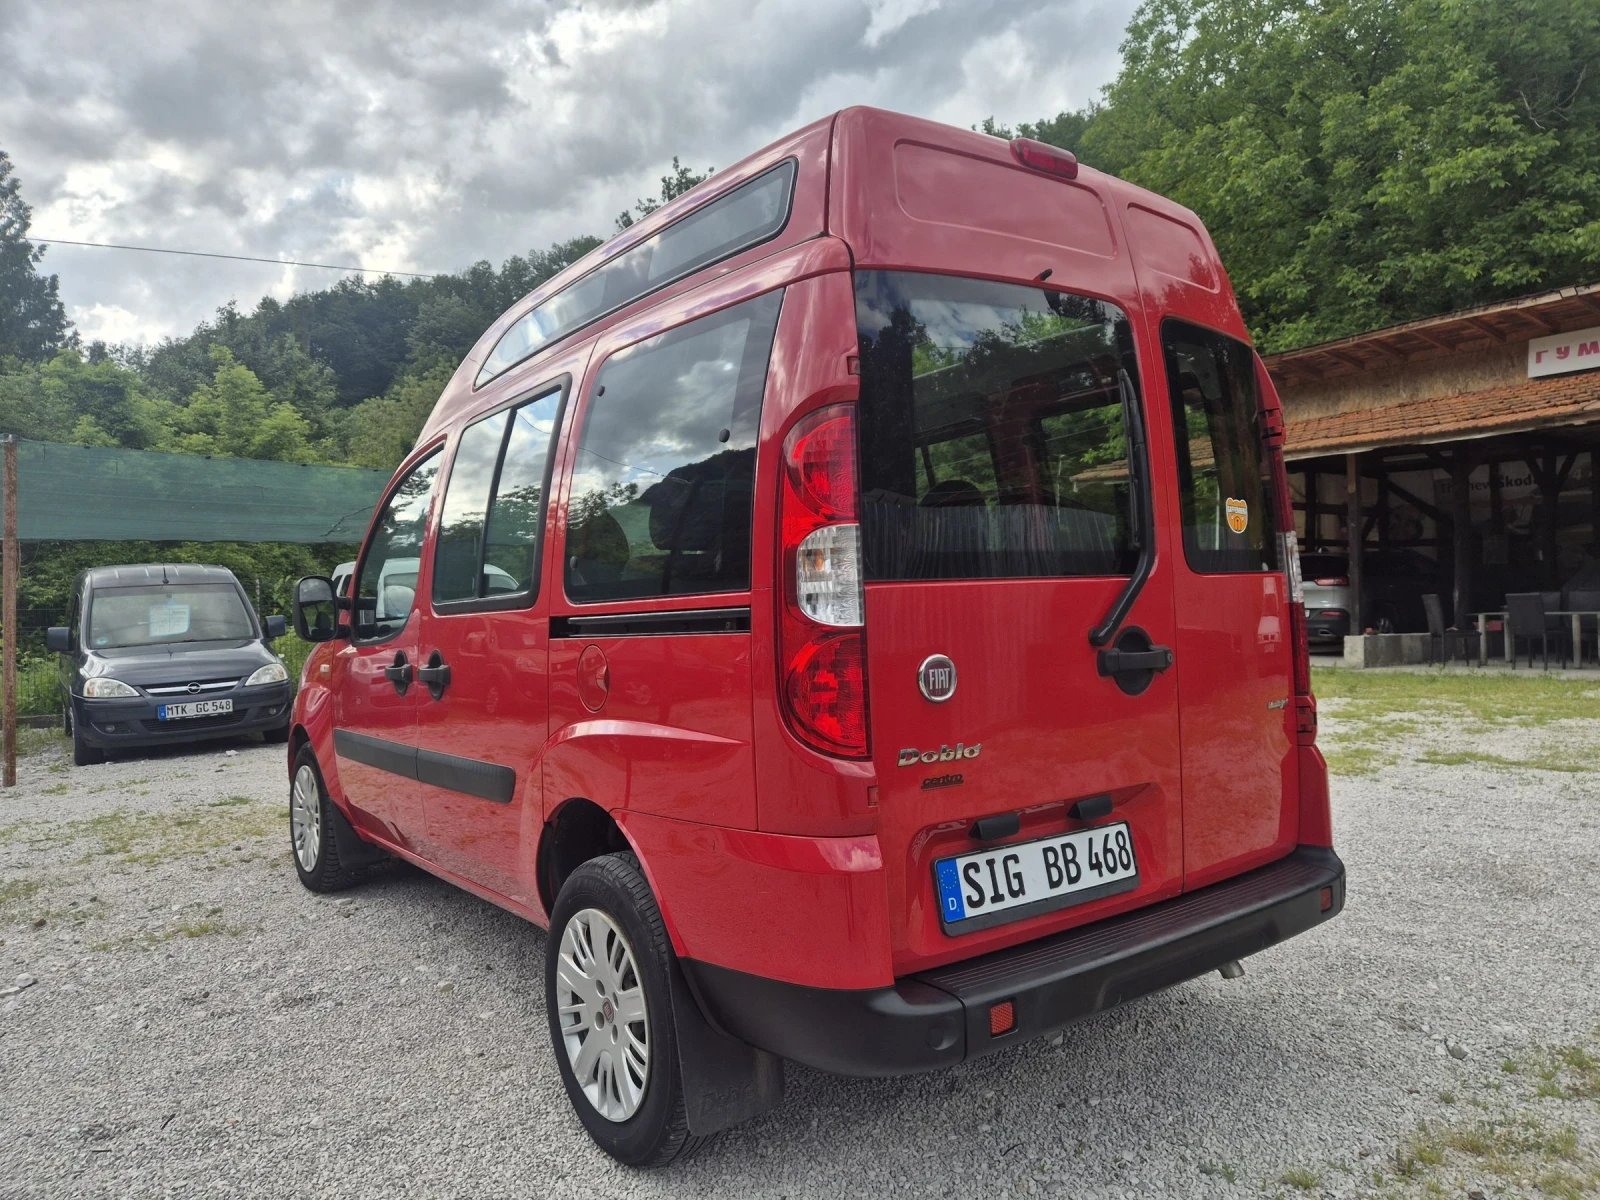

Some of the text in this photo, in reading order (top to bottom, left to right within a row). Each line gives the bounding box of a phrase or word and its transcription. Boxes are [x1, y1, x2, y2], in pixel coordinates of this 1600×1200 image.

[929, 667, 950, 690] FIAT
[167, 705, 188, 717] MTK
[195, 702, 210, 714] GC
[212, 700, 231, 712] 548
[948, 829, 1132, 911] D SIG BB 468
